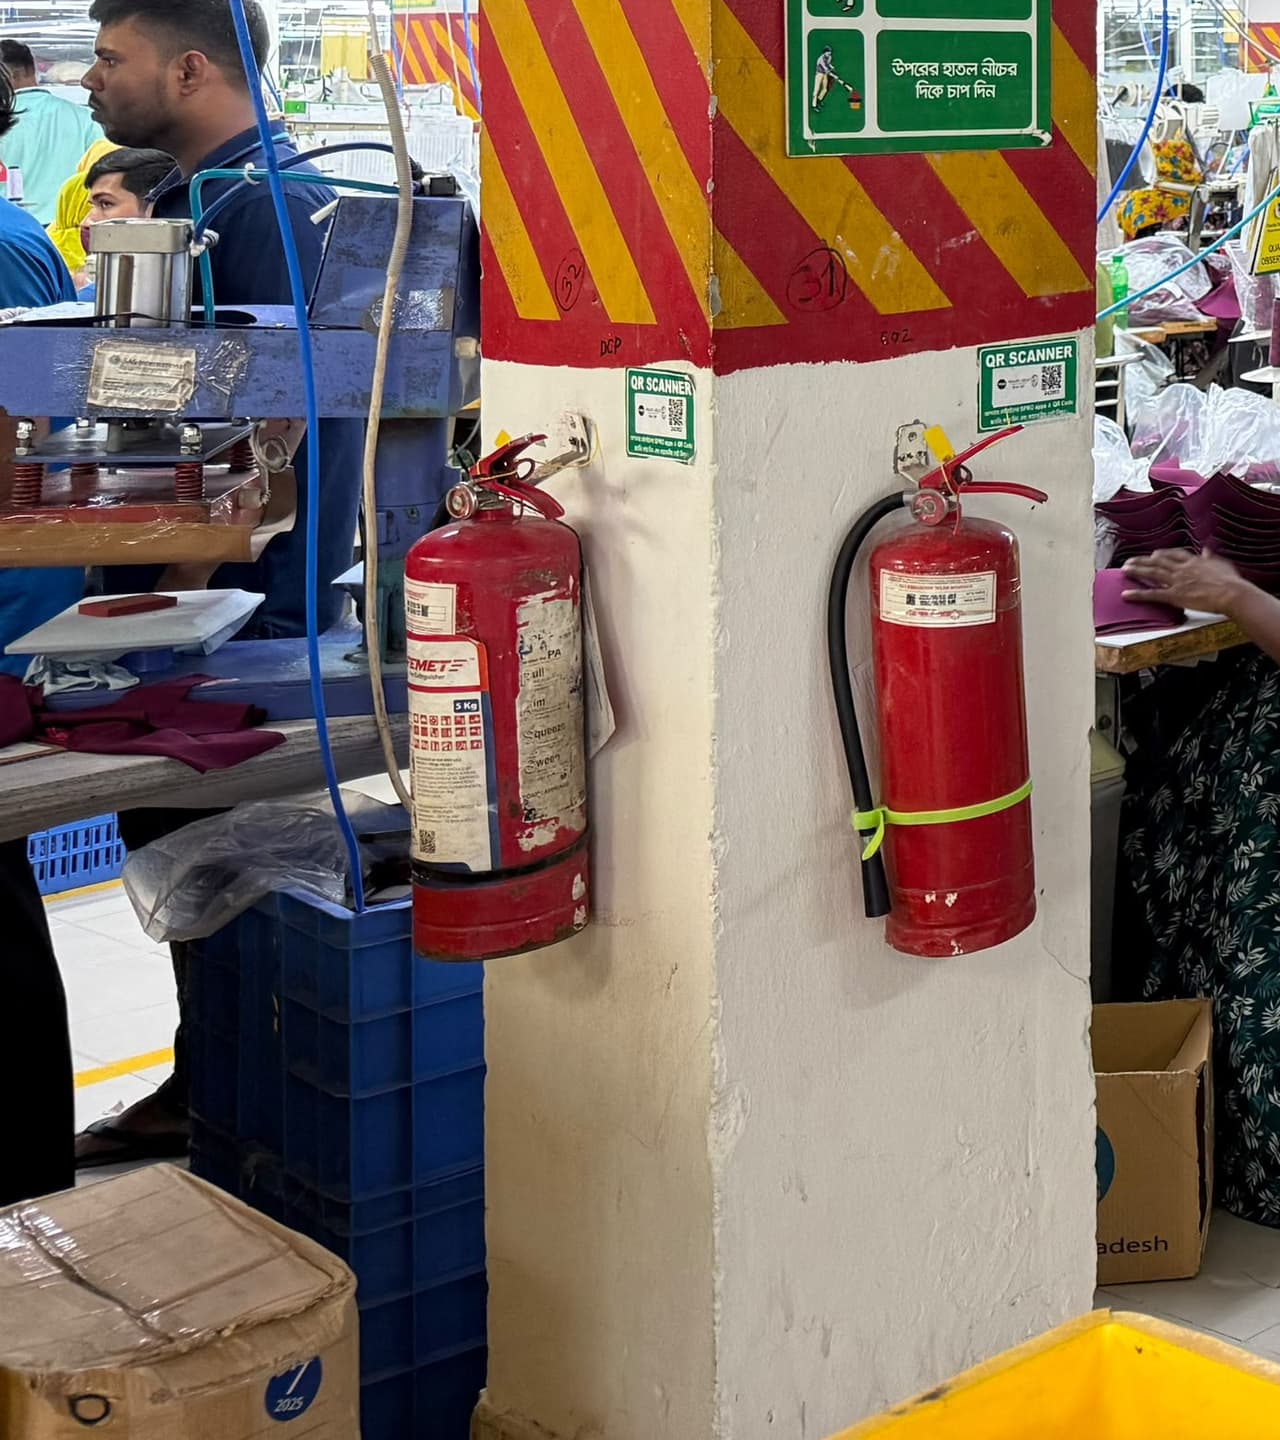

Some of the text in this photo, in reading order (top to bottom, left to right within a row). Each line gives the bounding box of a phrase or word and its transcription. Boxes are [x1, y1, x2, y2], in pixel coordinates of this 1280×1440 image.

[891, 57, 1019, 77] উপরের হাতল নীচের
[915, 81, 996, 100] দিকে চাপ দিন
[600, 337, 622, 357] DCP
[985, 345, 1073, 368] QR SCANNER
[630, 376, 693, 396] QR SCANNER
[463, 701, 478, 711] Kg
[1097, 1235, 1169, 1254] adesh
[273, 1397, 305, 1413] 2025
